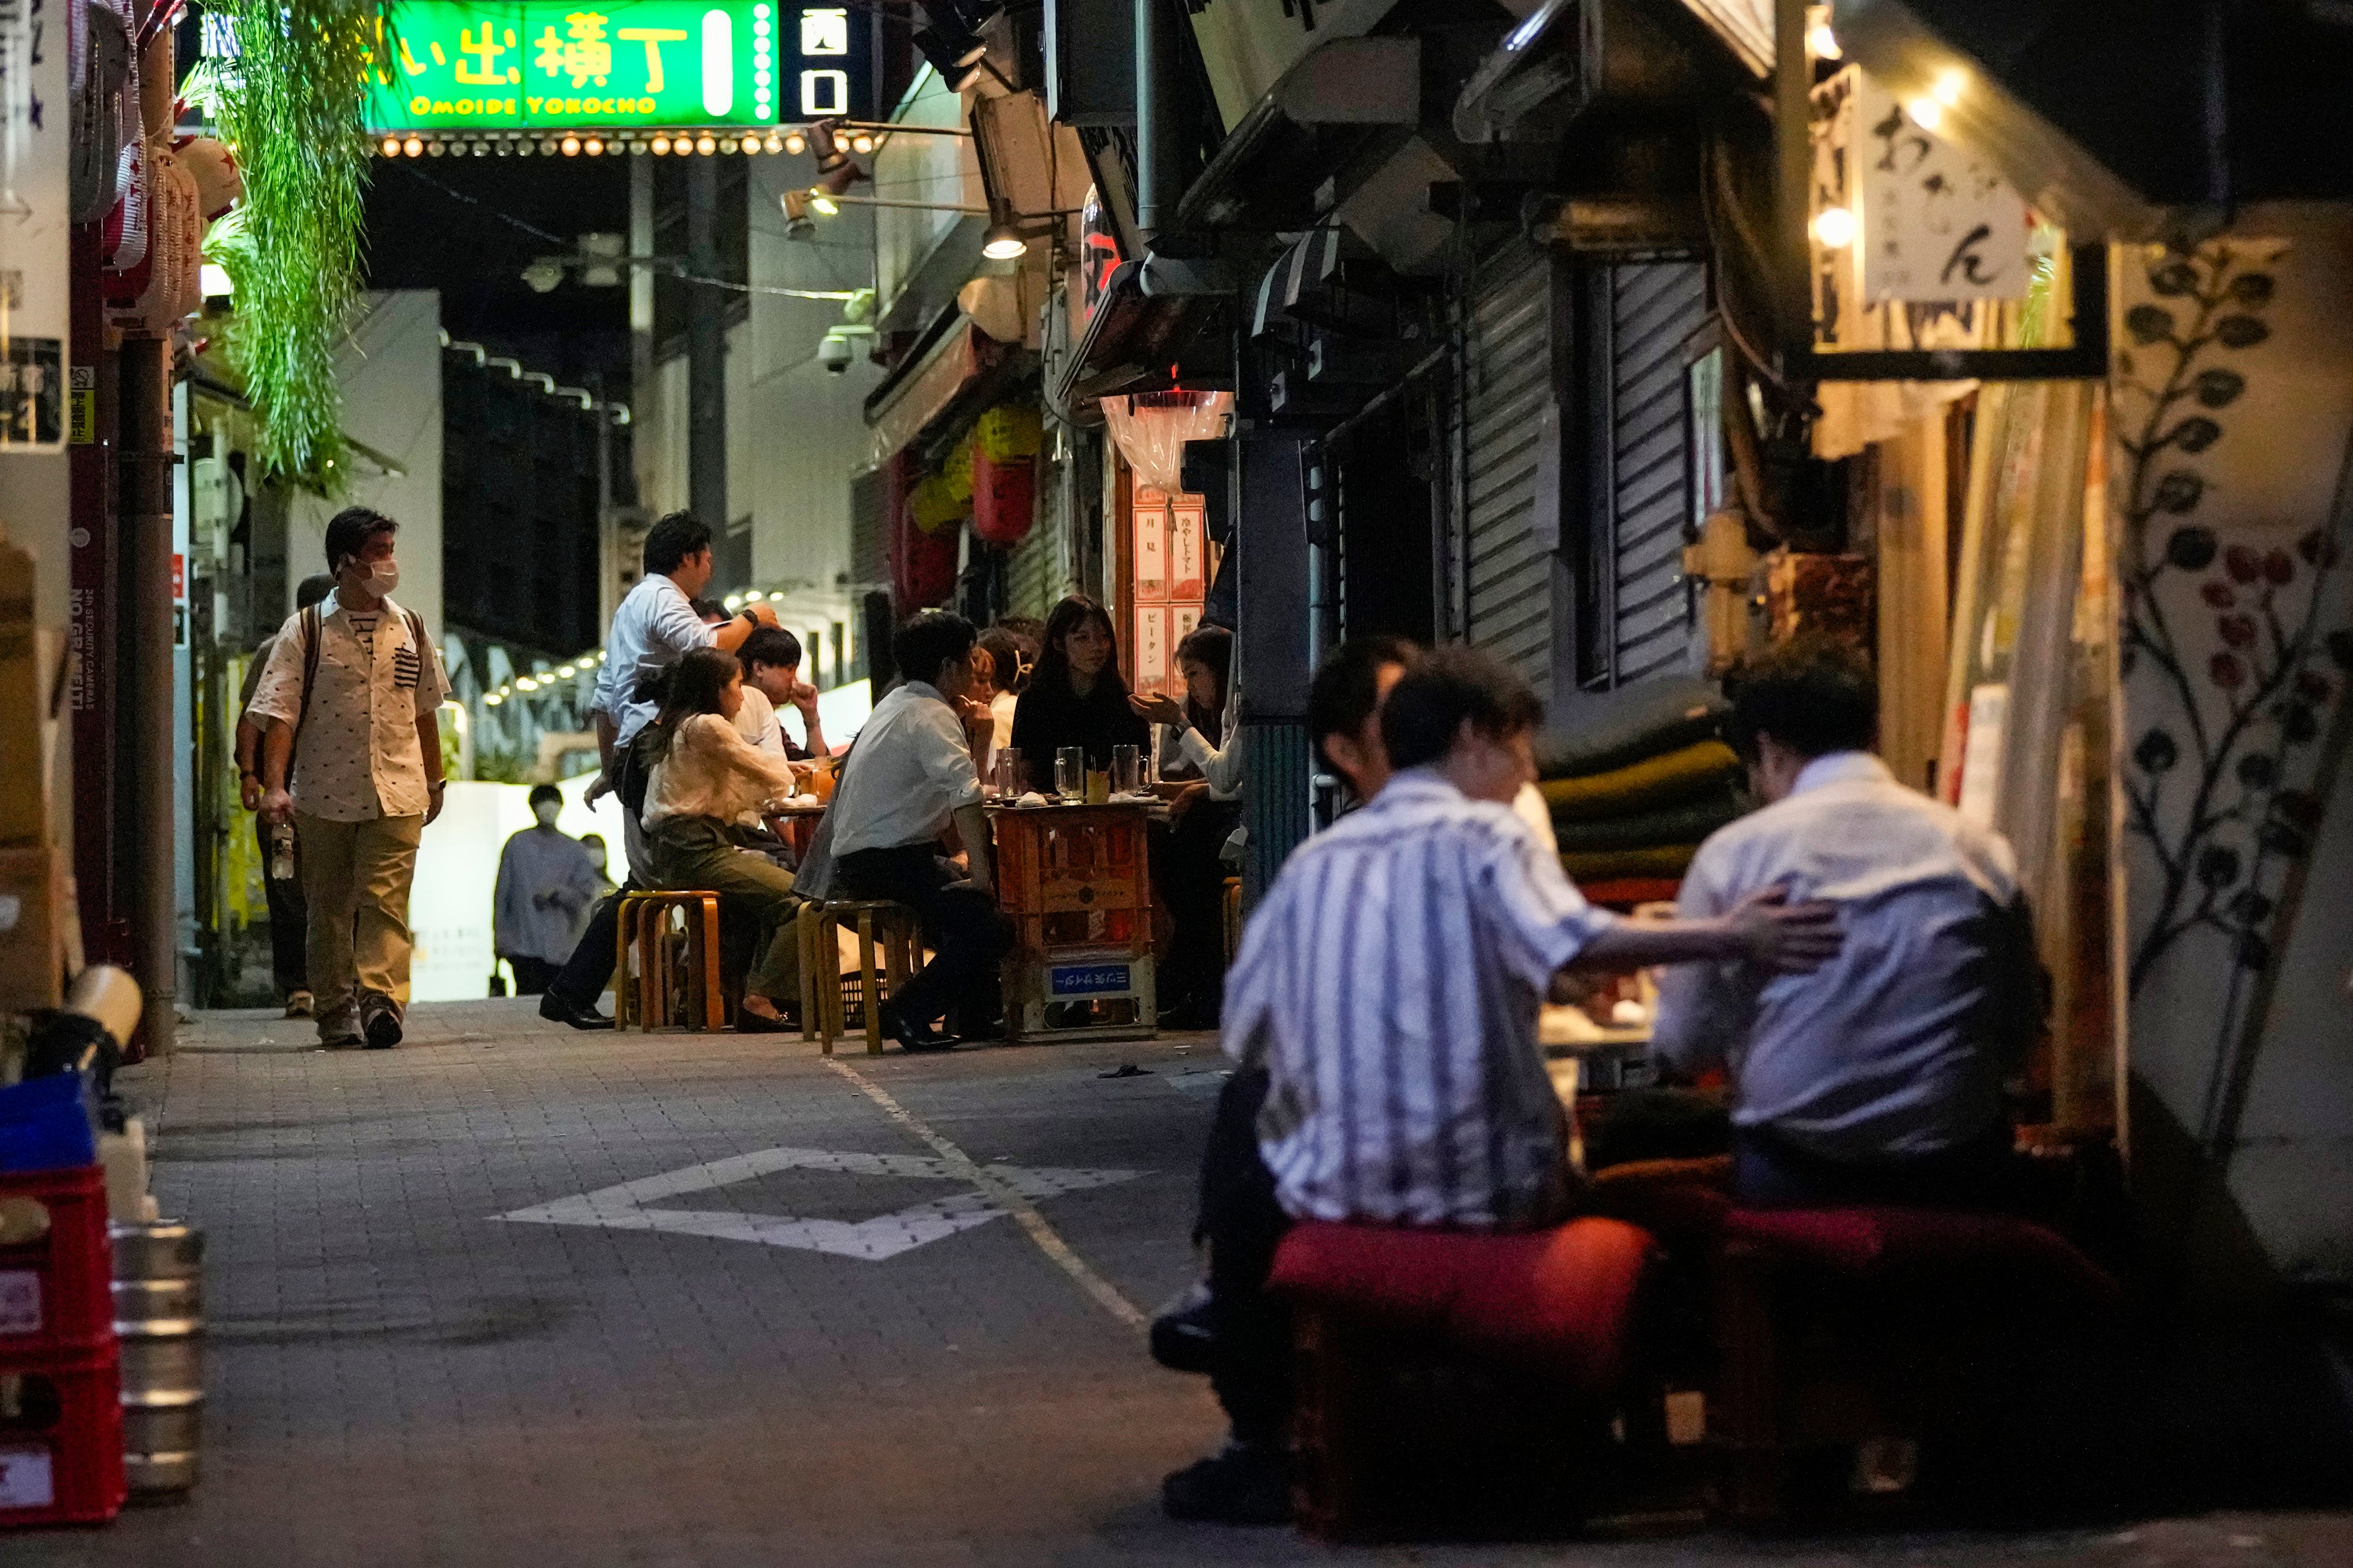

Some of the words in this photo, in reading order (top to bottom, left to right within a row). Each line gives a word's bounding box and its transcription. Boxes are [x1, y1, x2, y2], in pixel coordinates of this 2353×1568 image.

[801, 8, 847, 115] 西口
[410, 96, 516, 116] OMOIDE
[527, 96, 656, 115] YOKOCHO
[72, 589, 83, 616] NO
[86, 609, 94, 658] SECURITY
[86, 660, 94, 710] CAMERAS
[1056, 972, 1126, 988] 三ツ矢サイダー
